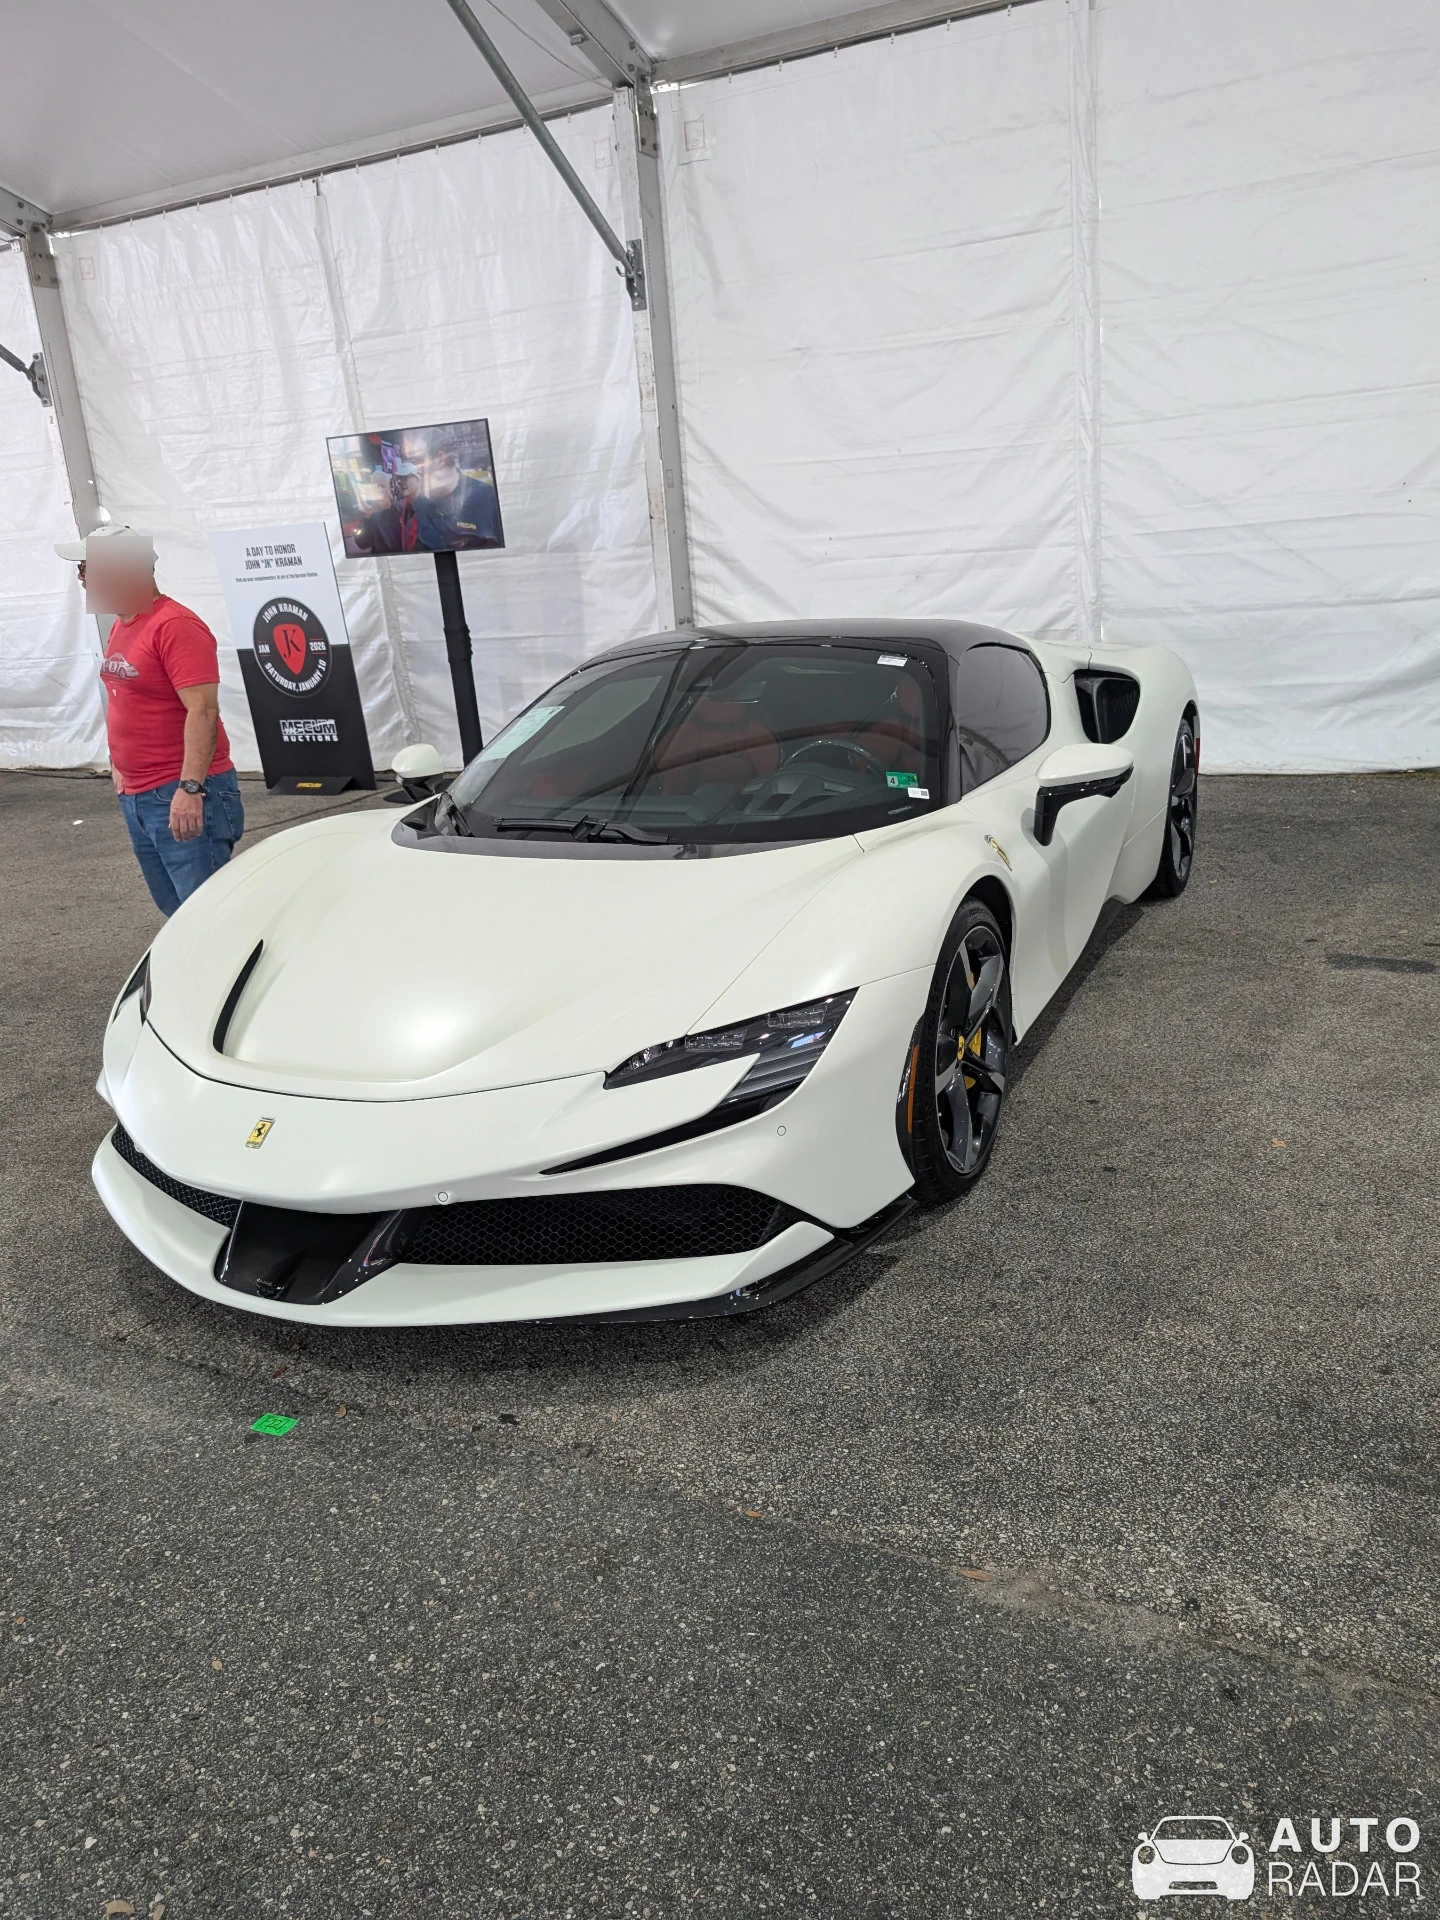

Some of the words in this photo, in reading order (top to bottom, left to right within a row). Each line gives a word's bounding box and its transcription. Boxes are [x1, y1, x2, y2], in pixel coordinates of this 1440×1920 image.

[245, 547, 252, 557] A
[251, 546, 264, 557] DAY
[264, 545, 274, 556] TO
[274, 543, 296, 555] HONOR
[245, 559, 261, 570] JOHN
[275, 556, 303, 568] KRAMAN
[262, 604, 278, 623] JOHN
[278, 603, 308, 621] KRAMAN
[258, 643, 271, 654] JAN
[309, 641, 326, 651] 2026
[299, 670, 323, 692] JANUARY
[317, 659, 327, 671] 10
[279, 719, 337, 735] MECUM
